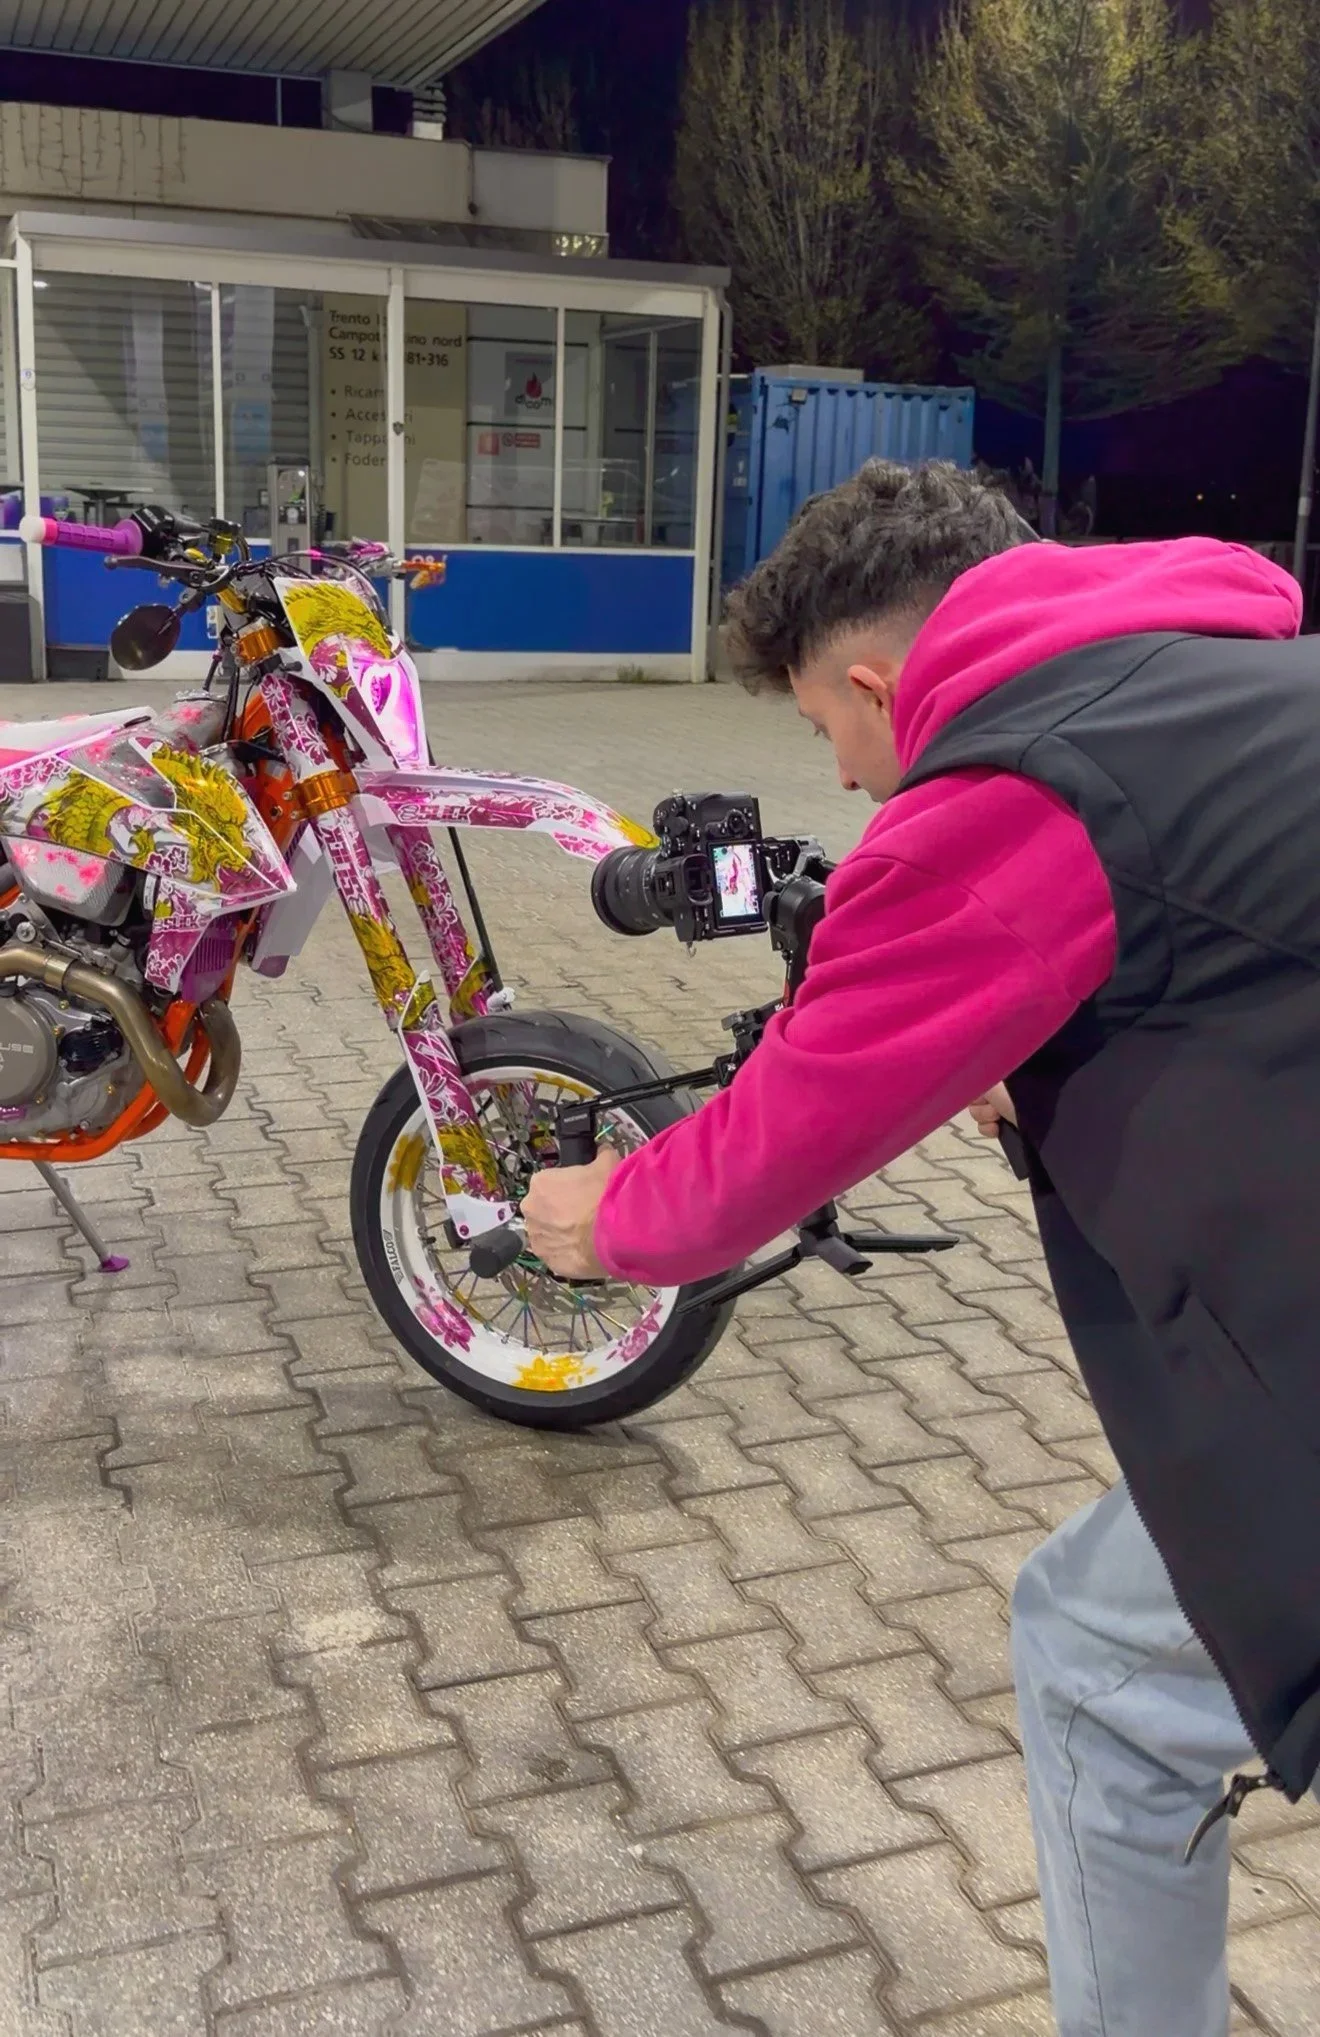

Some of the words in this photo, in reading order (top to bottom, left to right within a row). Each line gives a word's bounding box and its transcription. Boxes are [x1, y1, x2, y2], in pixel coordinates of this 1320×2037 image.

[329, 310, 371, 325] Trento
[432, 335, 462, 347] nord
[329, 347, 345, 360] SS
[352, 348, 365, 361] 12
[418, 804, 475, 821] SLICK
[163, 914, 201, 930] SLICK
[386, 1241, 401, 1272] FALCO
